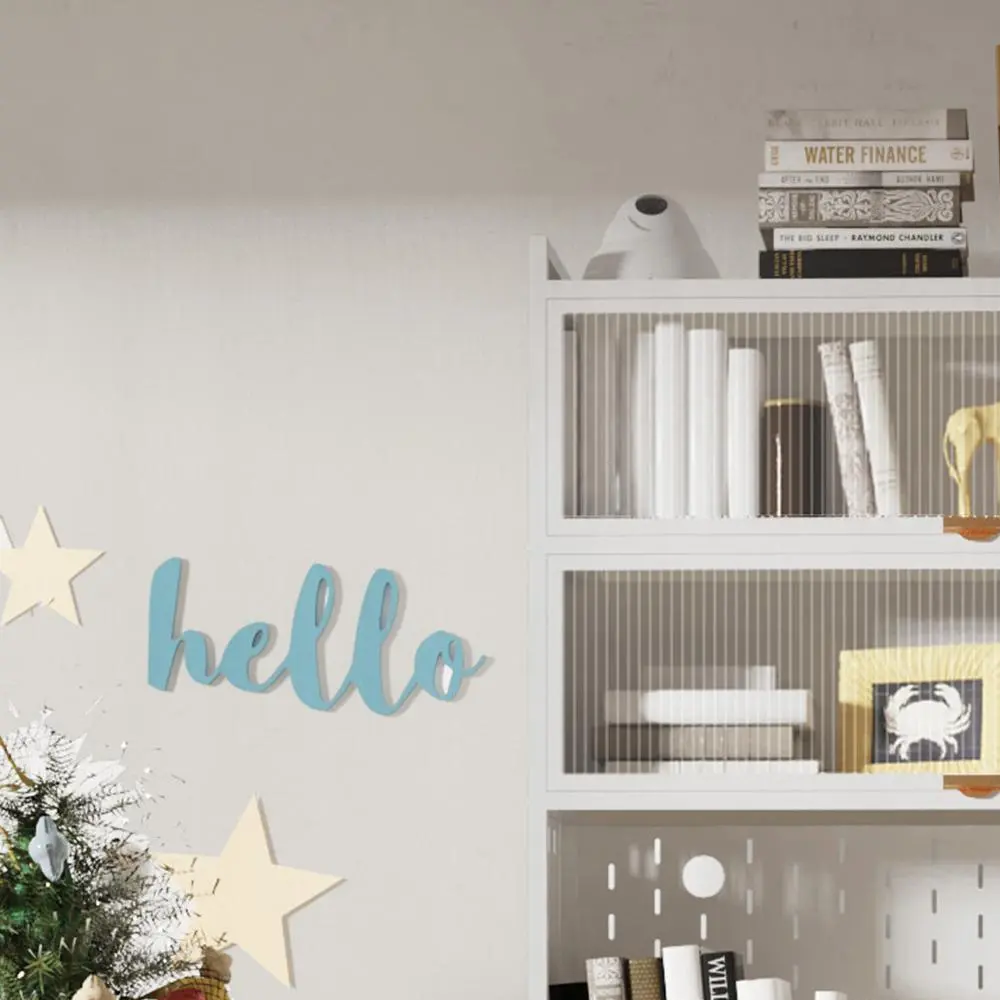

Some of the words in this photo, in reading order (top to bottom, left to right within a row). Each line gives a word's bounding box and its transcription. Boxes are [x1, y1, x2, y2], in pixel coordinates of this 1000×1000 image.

[804, 146, 854, 165] WATER
[860, 146, 927, 164] FINANCE
[779, 234, 795, 242] THE
[816, 234, 840, 242] SLEEP
[851, 233, 896, 242] RAYMOND
[898, 233, 944, 242] CHANDLER
[147, 556, 490, 716] hello
